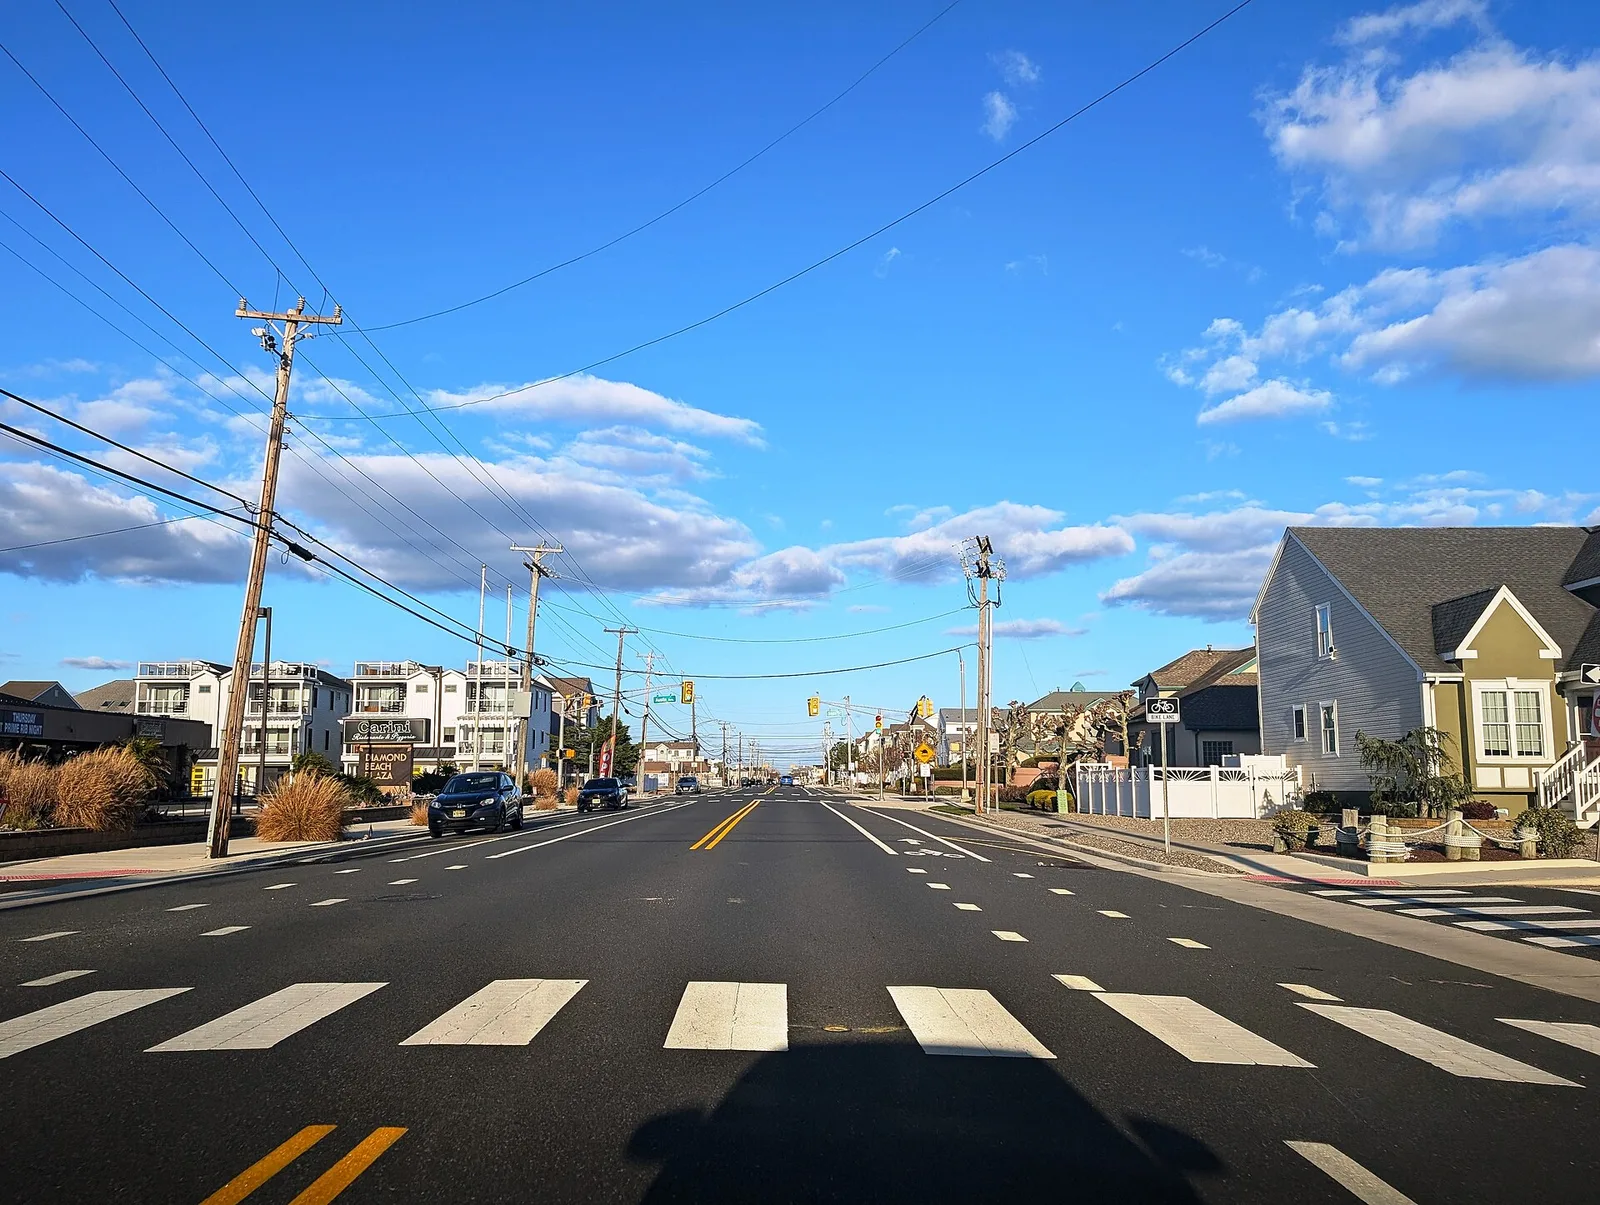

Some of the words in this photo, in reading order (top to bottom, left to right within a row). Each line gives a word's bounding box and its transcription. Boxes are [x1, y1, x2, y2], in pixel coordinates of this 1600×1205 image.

[12, 712, 37, 724] THURSDAY
[20, 723, 29, 735] RIB
[29, 724, 43, 735] NIGHT
[357, 720, 411, 734] Carini
[365, 753, 407, 762] DIAMOND
[364, 762, 392, 771] BEACH
